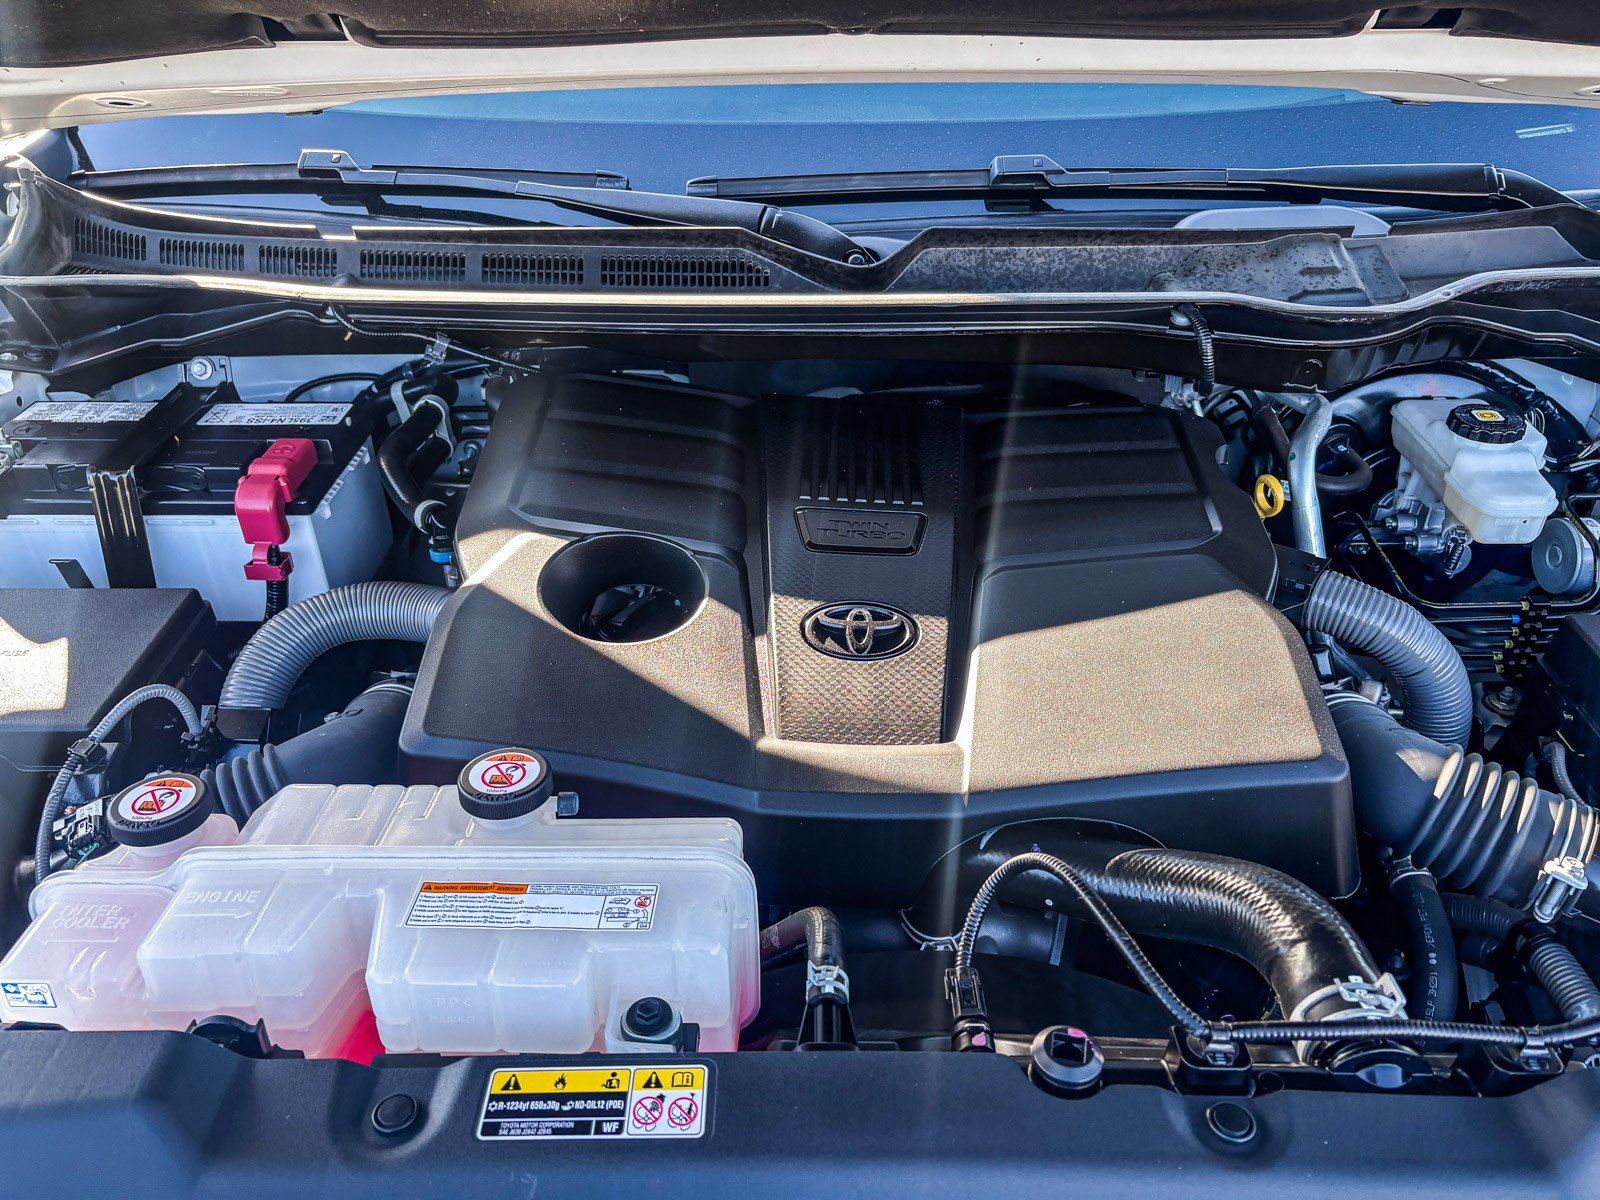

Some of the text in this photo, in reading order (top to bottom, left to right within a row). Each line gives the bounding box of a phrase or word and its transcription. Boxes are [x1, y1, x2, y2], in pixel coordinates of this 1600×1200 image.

[828, 519, 889, 530] TWIN
[816, 527, 906, 540] TURBO
[186, 890, 261, 904] ENGINE
[58, 904, 123, 917] INTER
[52, 916, 130, 930] COOLER
[497, 1100, 624, 1111] R-1234yf 650±30g ND-OIL12 (POE)
[602, 1122, 620, 1133] WF
